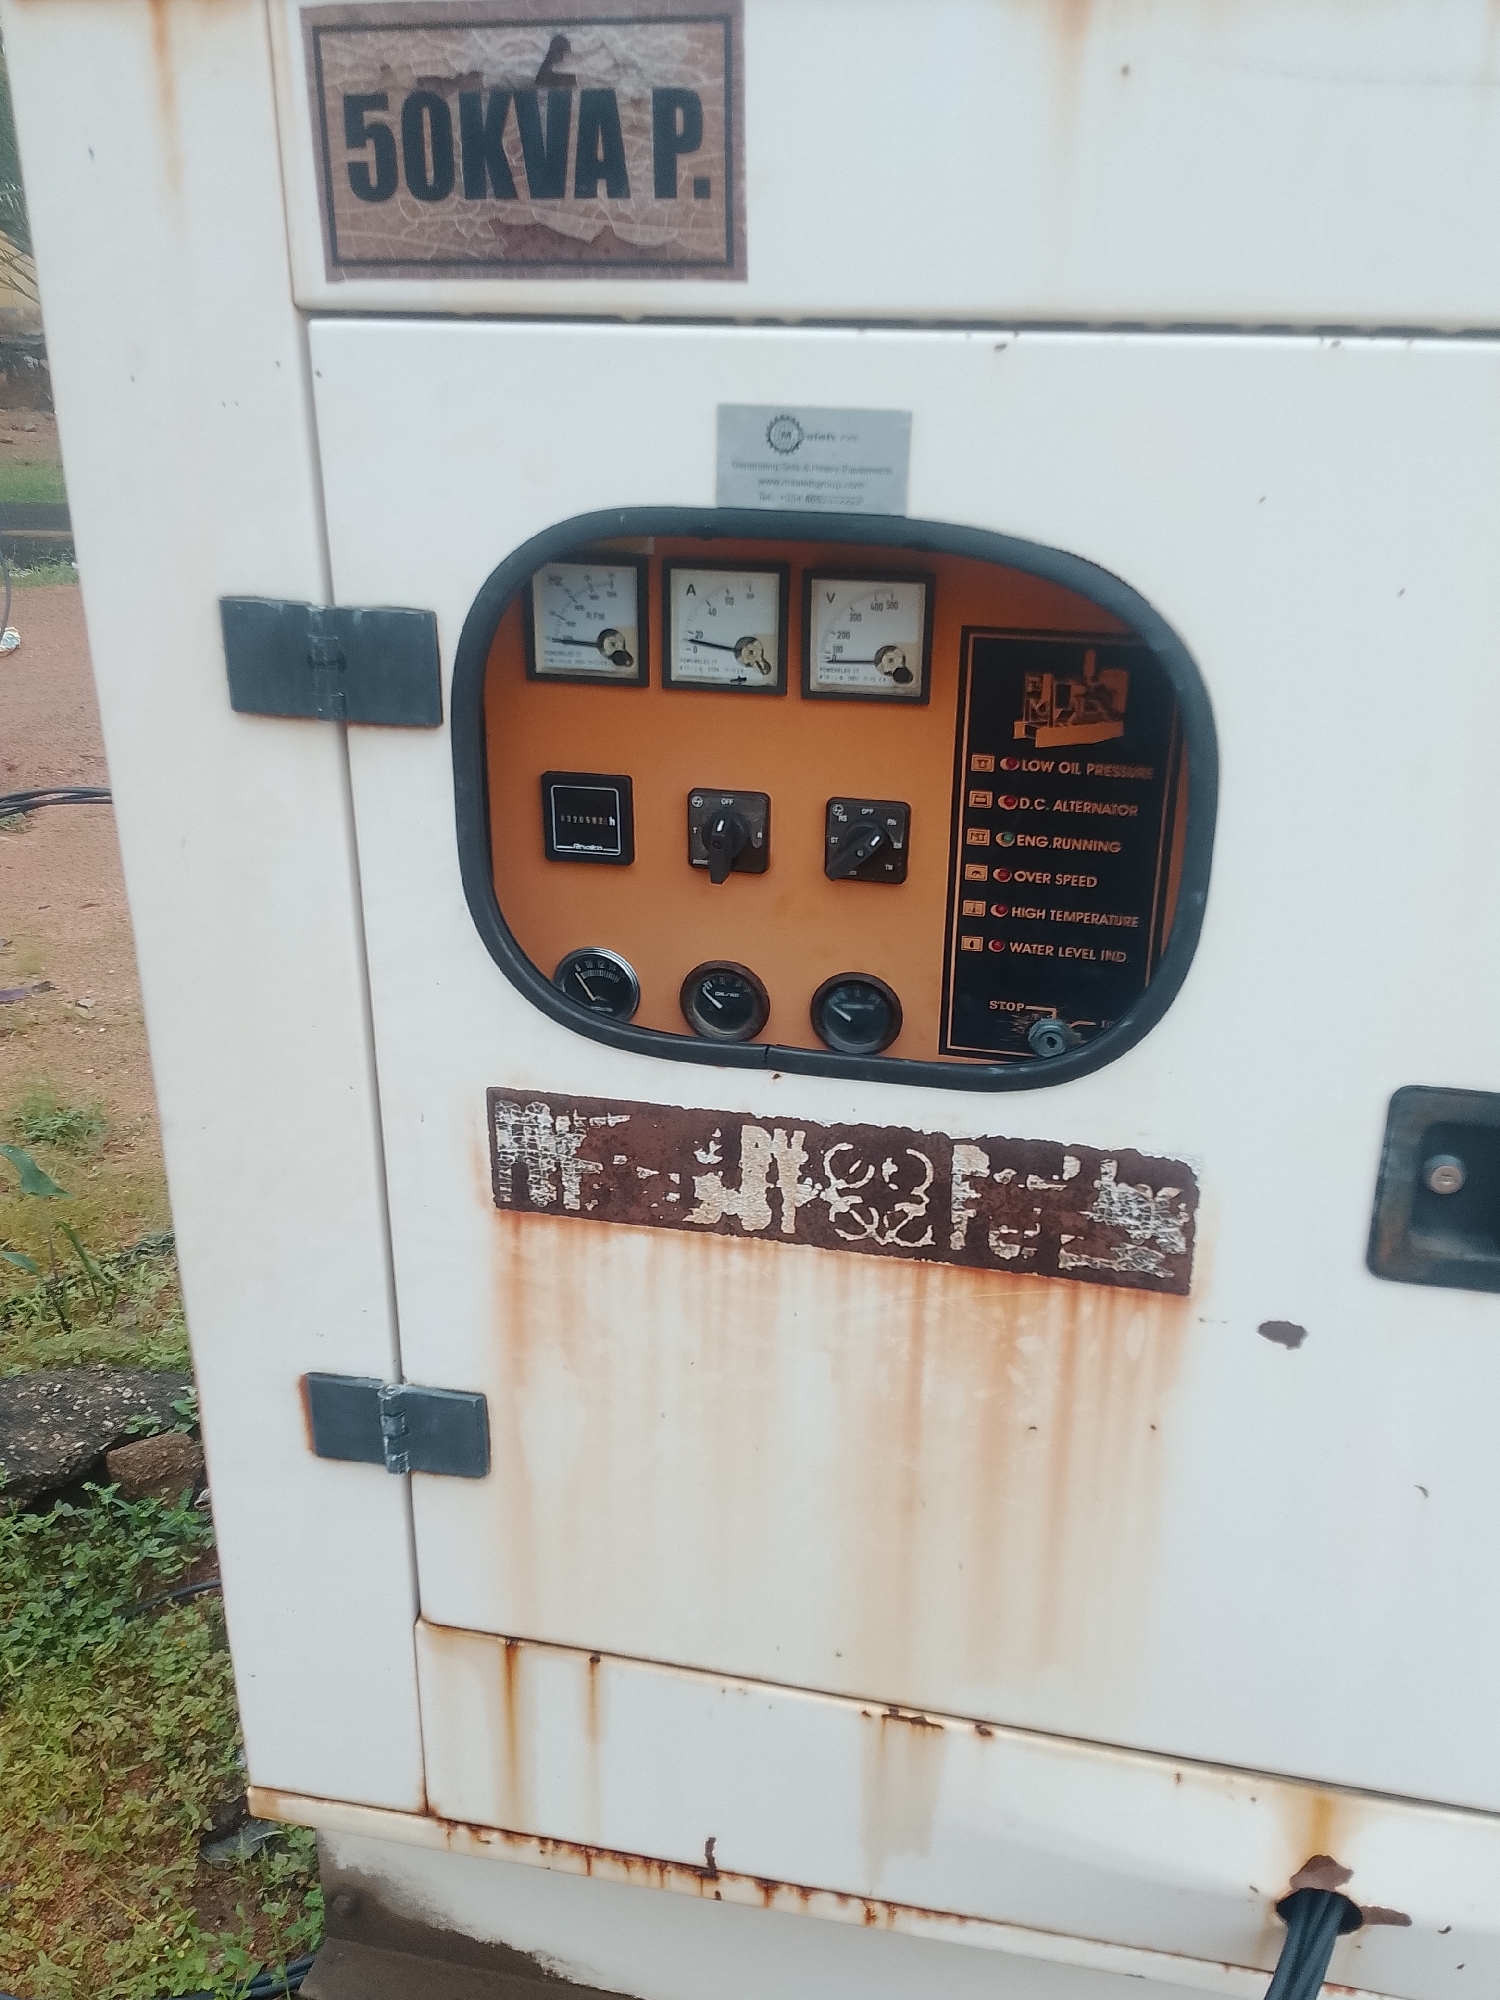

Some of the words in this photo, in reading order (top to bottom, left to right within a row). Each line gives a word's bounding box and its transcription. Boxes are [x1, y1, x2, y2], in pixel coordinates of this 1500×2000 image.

[342, 87, 631, 203] 50KVA
[686, 583, 697, 597] A
[826, 591, 836, 605] V
[870, 601, 884, 613] 400
[886, 600, 899, 611] 500
[836, 630, 851, 641] 200
[1021, 758, 1055, 774] LOW
[1058, 760, 1082, 776] OIL
[1086, 762, 1155, 781] PRESSURE
[720, 798, 735, 806] OFF
[1019, 796, 1050, 811] D.C.
[1052, 799, 1139, 817] ALTERNATOR
[1013, 869, 1052, 886] OVER
[1055, 872, 1098, 889] SPEED
[1011, 905, 1046, 921] HIGH
[1049, 908, 1140, 929] TEMPERATURE
[1008, 940, 1055, 957] WATER
[1058, 946, 1097, 961] LEVEL
[988, 1000, 1026, 1013] STOP
